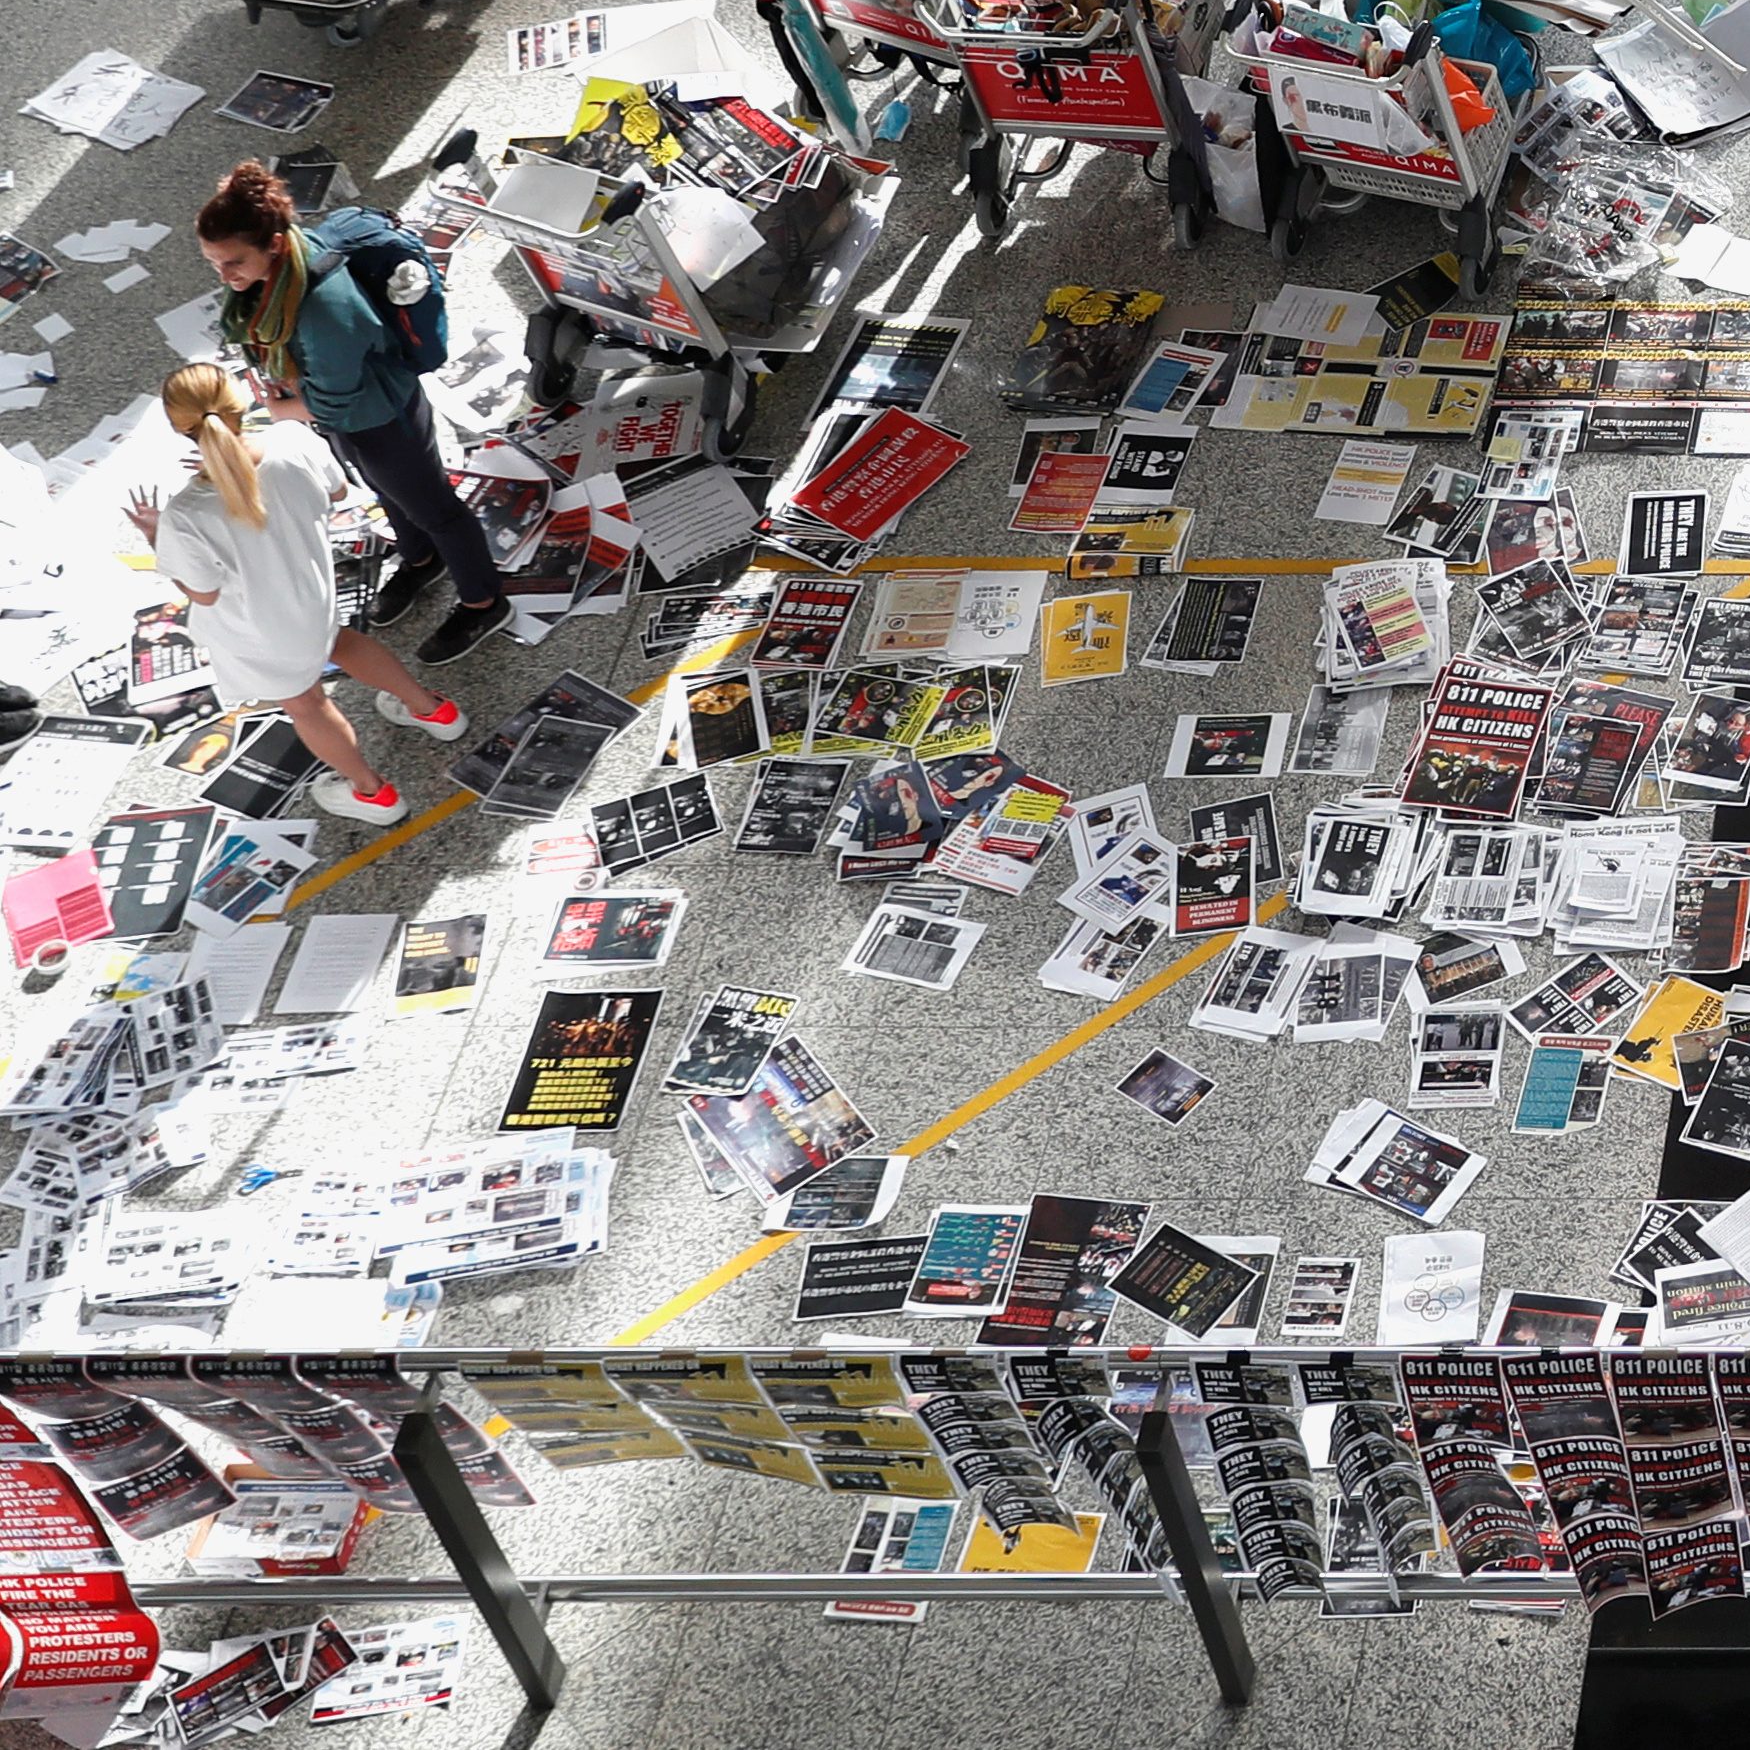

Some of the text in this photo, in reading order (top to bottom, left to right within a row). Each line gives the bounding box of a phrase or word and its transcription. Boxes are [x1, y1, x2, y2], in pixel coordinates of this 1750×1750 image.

[1394, 155, 1456, 176] QIMA
[616, 416, 640, 452] FIGHT
[781, 603, 844, 616] 香港市民
[1447, 685, 1545, 710] 811 POLICE
[1613, 703, 1662, 725] PLEASE
[1435, 715, 1534, 739] HK CITIZENS
[1570, 825, 1675, 839] Hong Kong not safe
[1189, 908, 1237, 918] PERMANENT
[1317, 973, 1341, 1009] 811
[905, 1363, 940, 1376] THEY
[1202, 1363, 1235, 1377] THEY
[1406, 1361, 1494, 1377] 811 POLICE
[1614, 1359, 1703, 1375] 811 POLICE
[1719, 1357, 1746, 1373] 811
[1409, 1385, 1499, 1397] HK CITIZENS
[1618, 1385, 1708, 1396] HK CITIZENS
[24, 1577, 87, 1588] POLICE
[2, 1589, 76, 1600] FIRE THE
[29, 1632, 136, 1648] PROTESTERS
[29, 1647, 148, 1665] RESIDENTS OR
[23, 1664, 134, 1682] PASSENGERS
